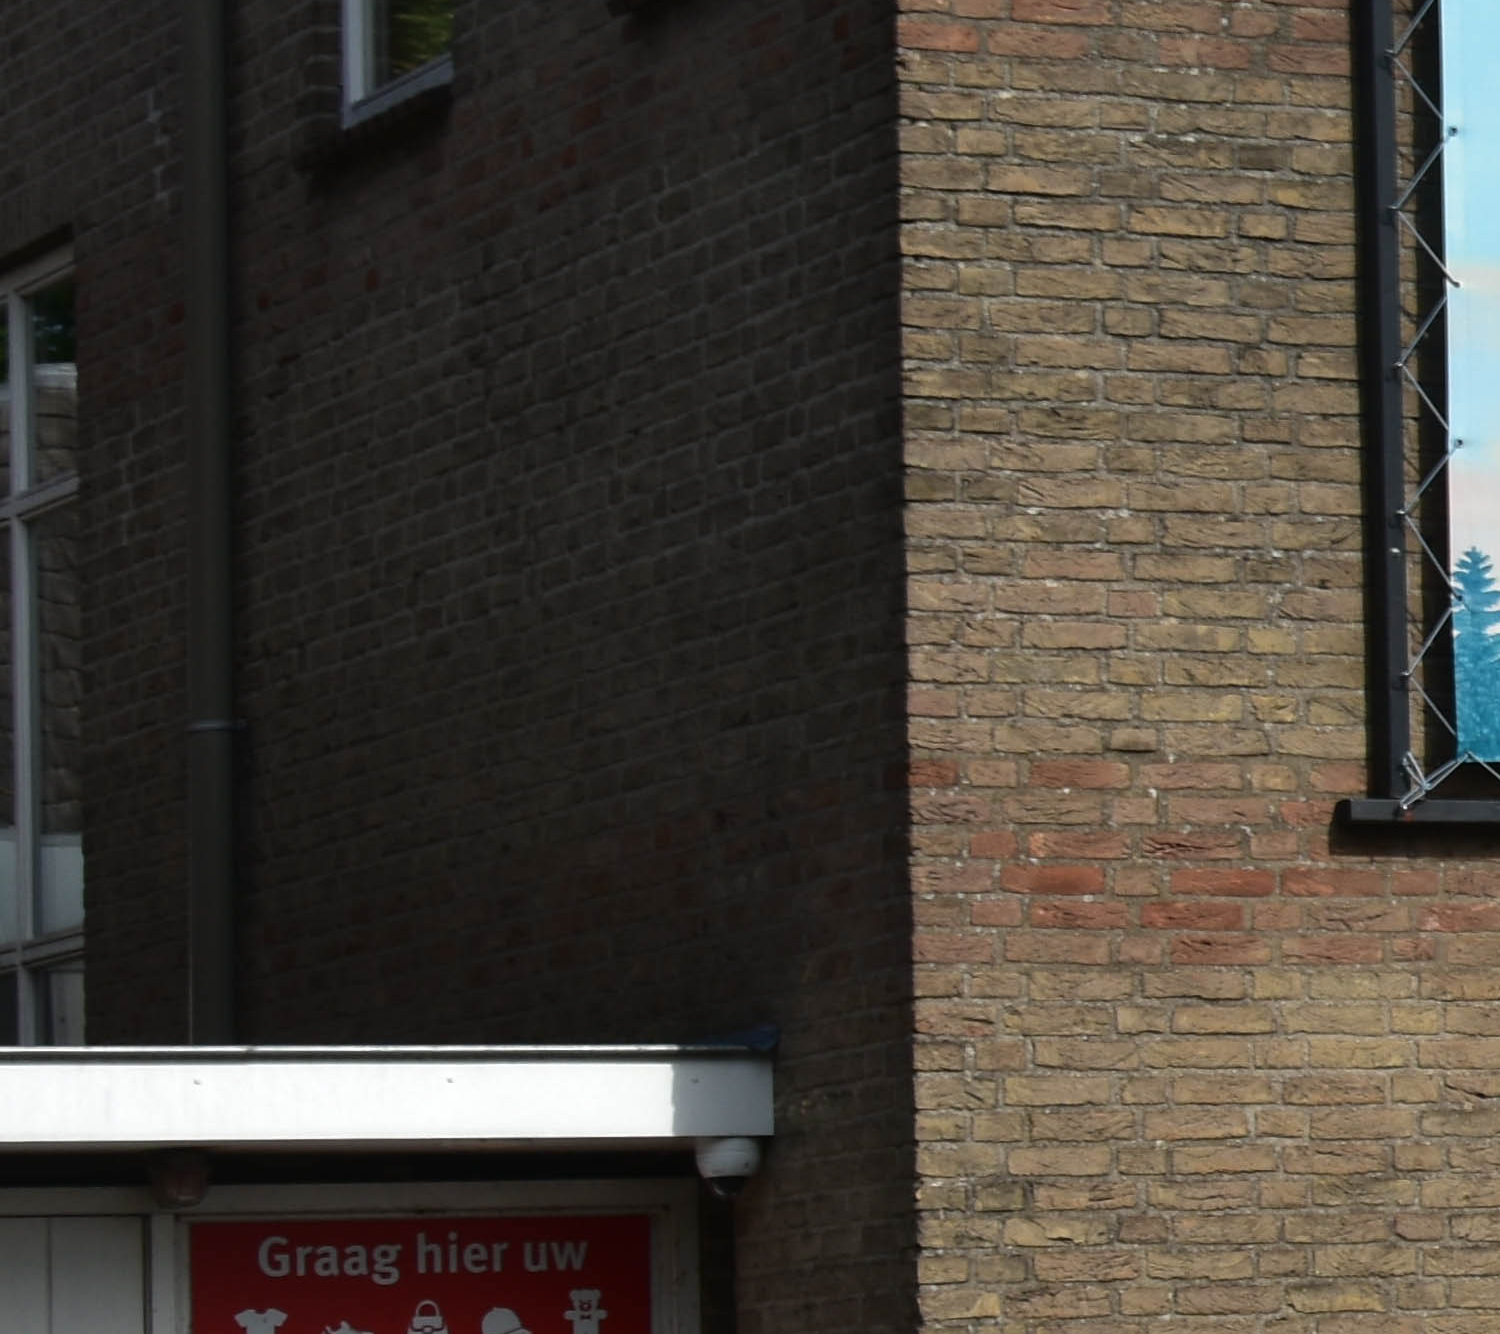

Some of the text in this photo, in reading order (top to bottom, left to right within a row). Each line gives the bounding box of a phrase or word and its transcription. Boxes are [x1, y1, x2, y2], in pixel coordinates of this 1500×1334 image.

[258, 1232, 588, 1286] Graag hier uw
